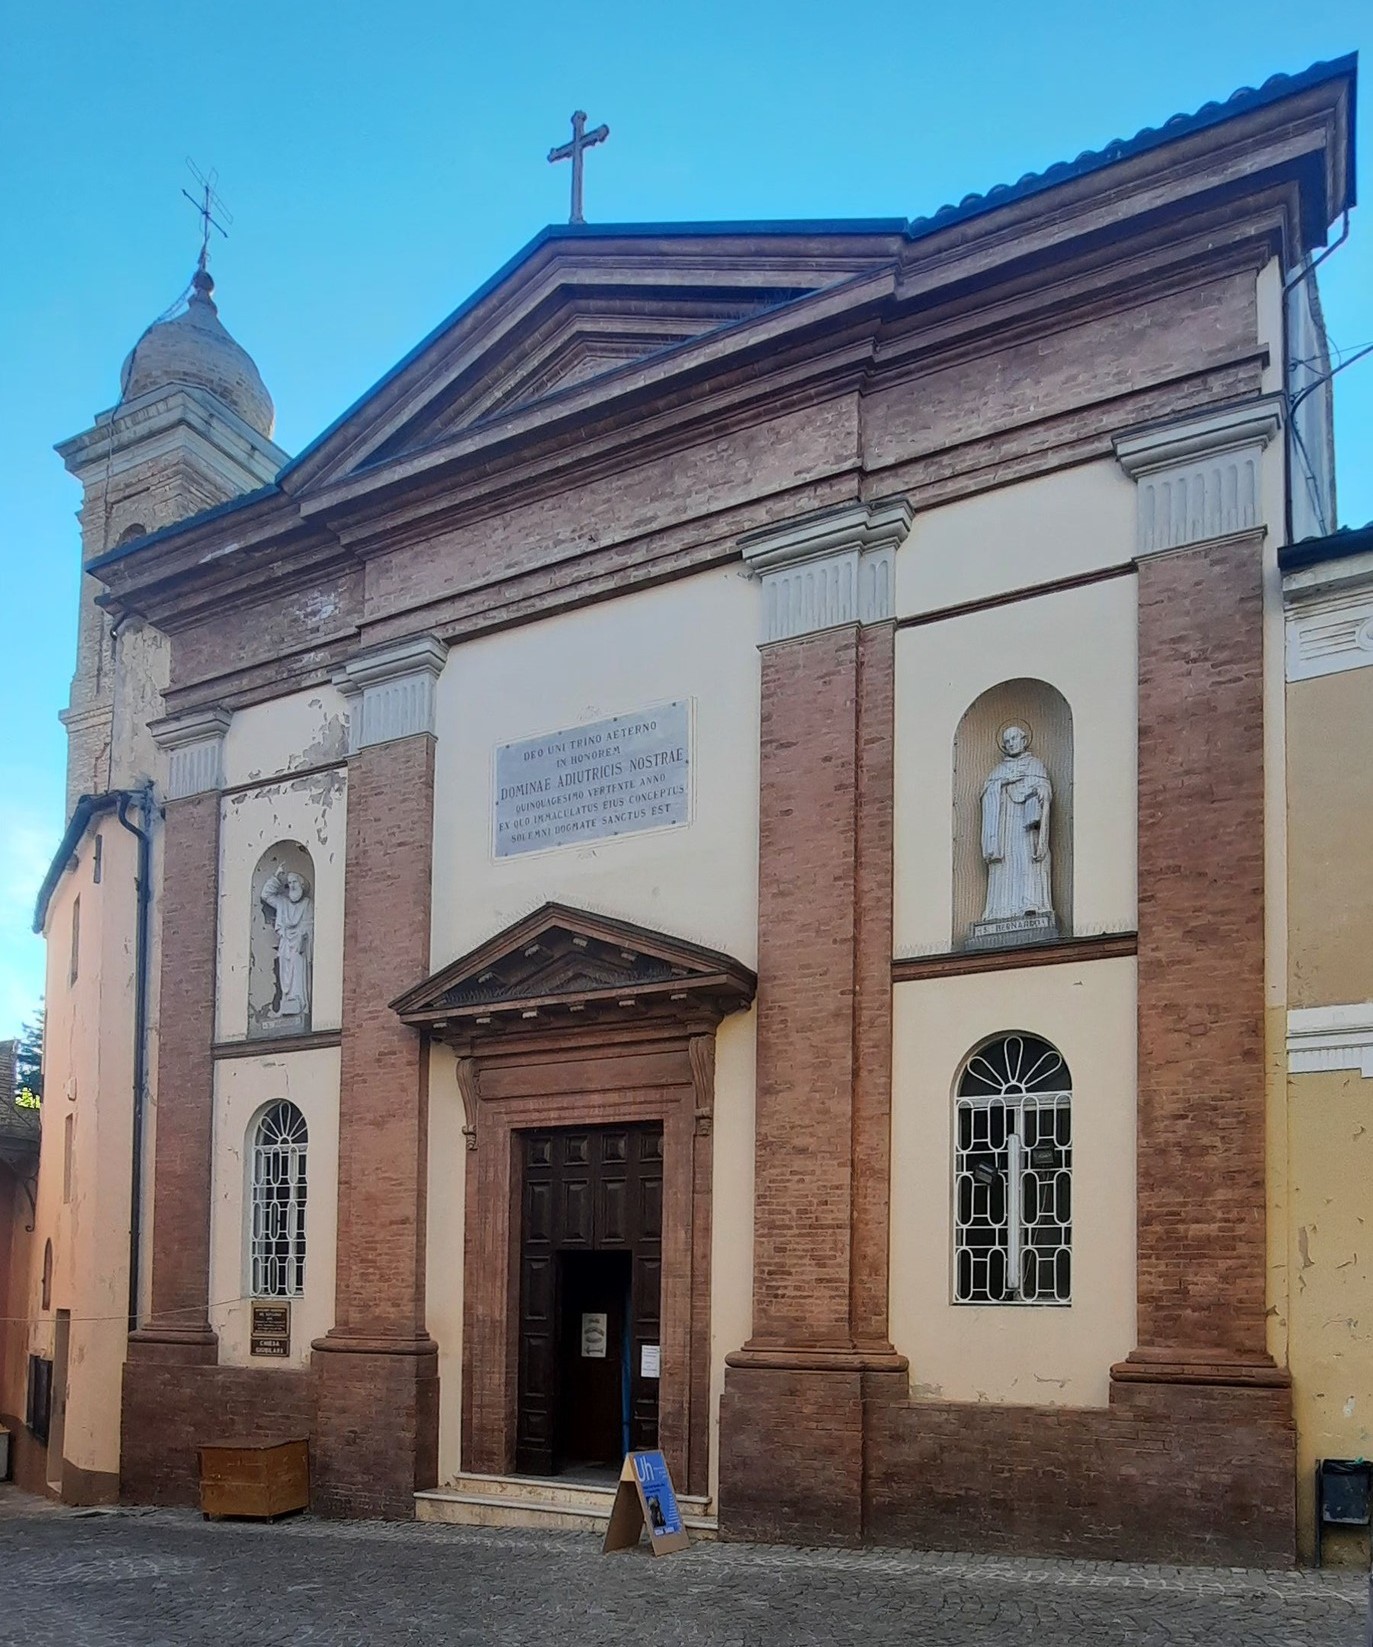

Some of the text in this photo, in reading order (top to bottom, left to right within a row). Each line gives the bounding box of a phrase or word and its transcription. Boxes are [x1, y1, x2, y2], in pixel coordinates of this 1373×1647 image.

[524, 721, 657, 761] DEO UNI TRINO AETERNO
[557, 746, 620, 768] IN HONOREM
[501, 748, 683, 800] DOMINAE ADIUTRICIS NOSTRAE
[516, 774, 665, 813] QUINQUAGESIMO VERTENTE ANNO
[499, 786, 684, 831] EX QUO IMMACULATUS EIUS CONCEPTUS
[511, 804, 671, 843] SOLEMNI DOGMATE SANCTUS EST
